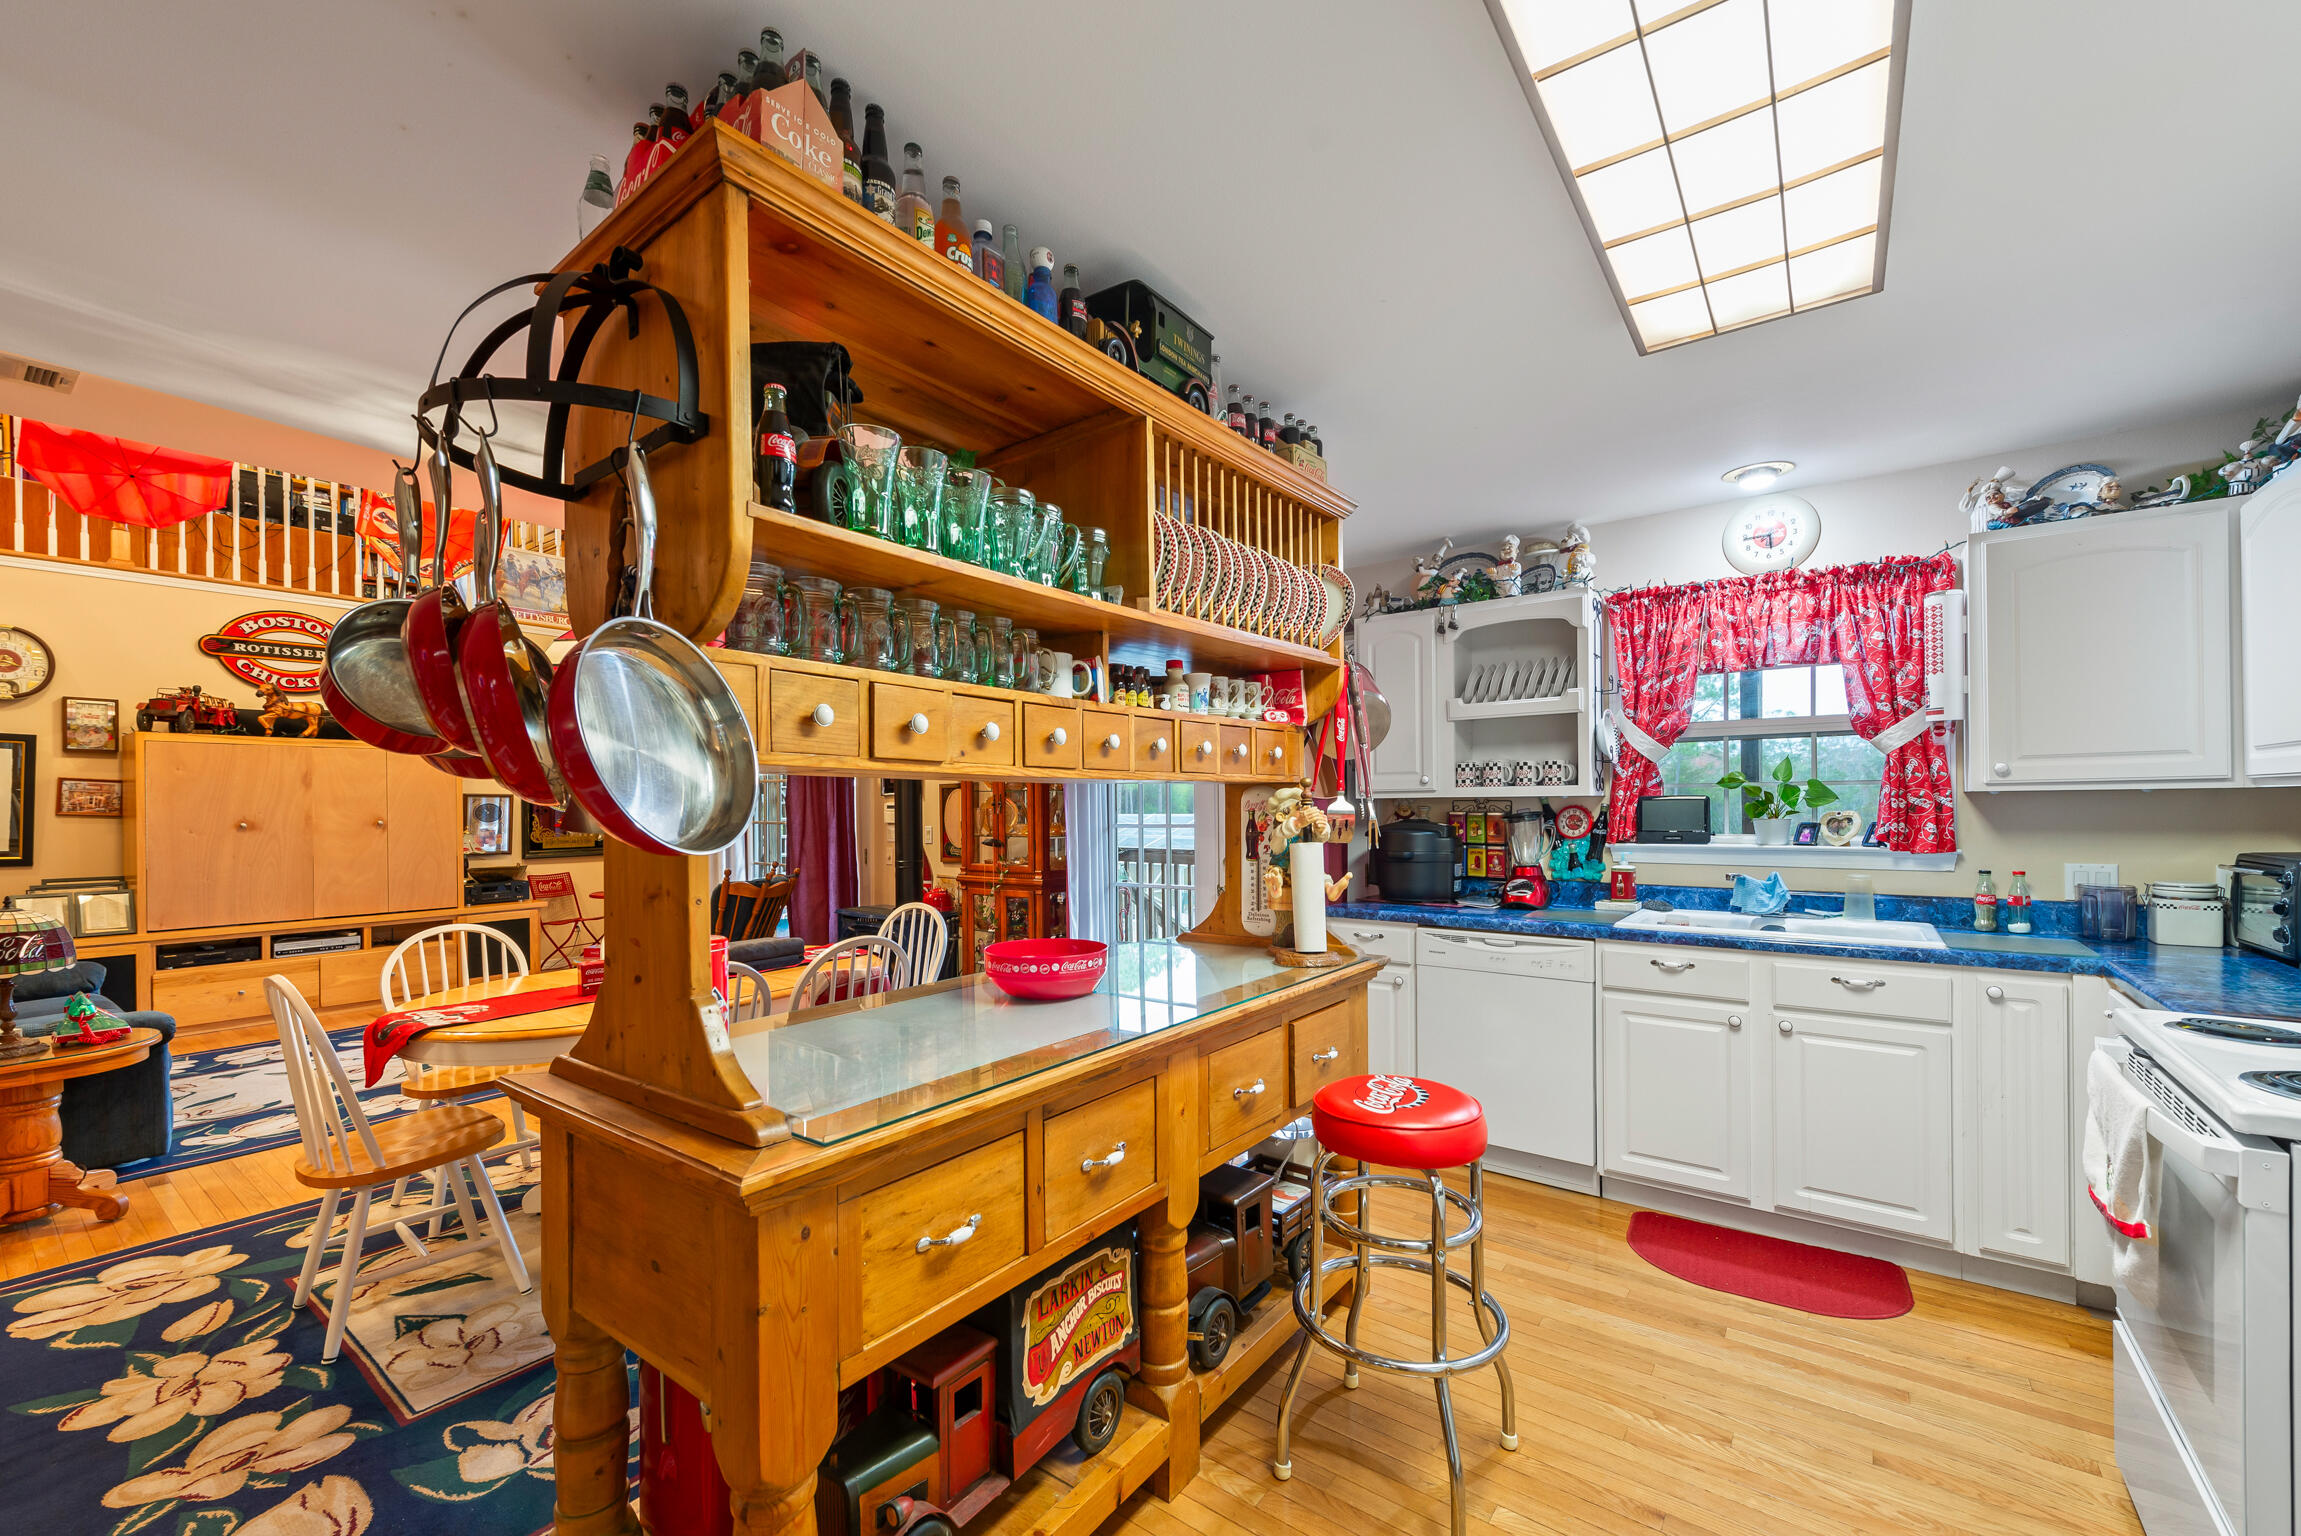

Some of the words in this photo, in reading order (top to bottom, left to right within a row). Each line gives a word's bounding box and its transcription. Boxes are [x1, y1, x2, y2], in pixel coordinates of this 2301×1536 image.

[765, 96, 791, 117] SERVE
[813, 127, 836, 146] COLD
[771, 113, 832, 168] Coke
[1173, 333, 1206, 365] TWININGS
[232, 642, 326, 658] ROTISSER
[235, 658, 321, 689] CHICK
[1060, 959, 1088, 972] Coca-Cola
[1353, 1074, 1414, 1115] Coca-Cola
[1037, 1265, 1094, 1322] LARKIN
[1098, 1263, 1108, 1279] &
[1050, 1294, 1088, 1362] ANCHOR
[1087, 1272, 1124, 1305] BISCUITS
[1072, 1311, 1126, 1367] NEWTON
